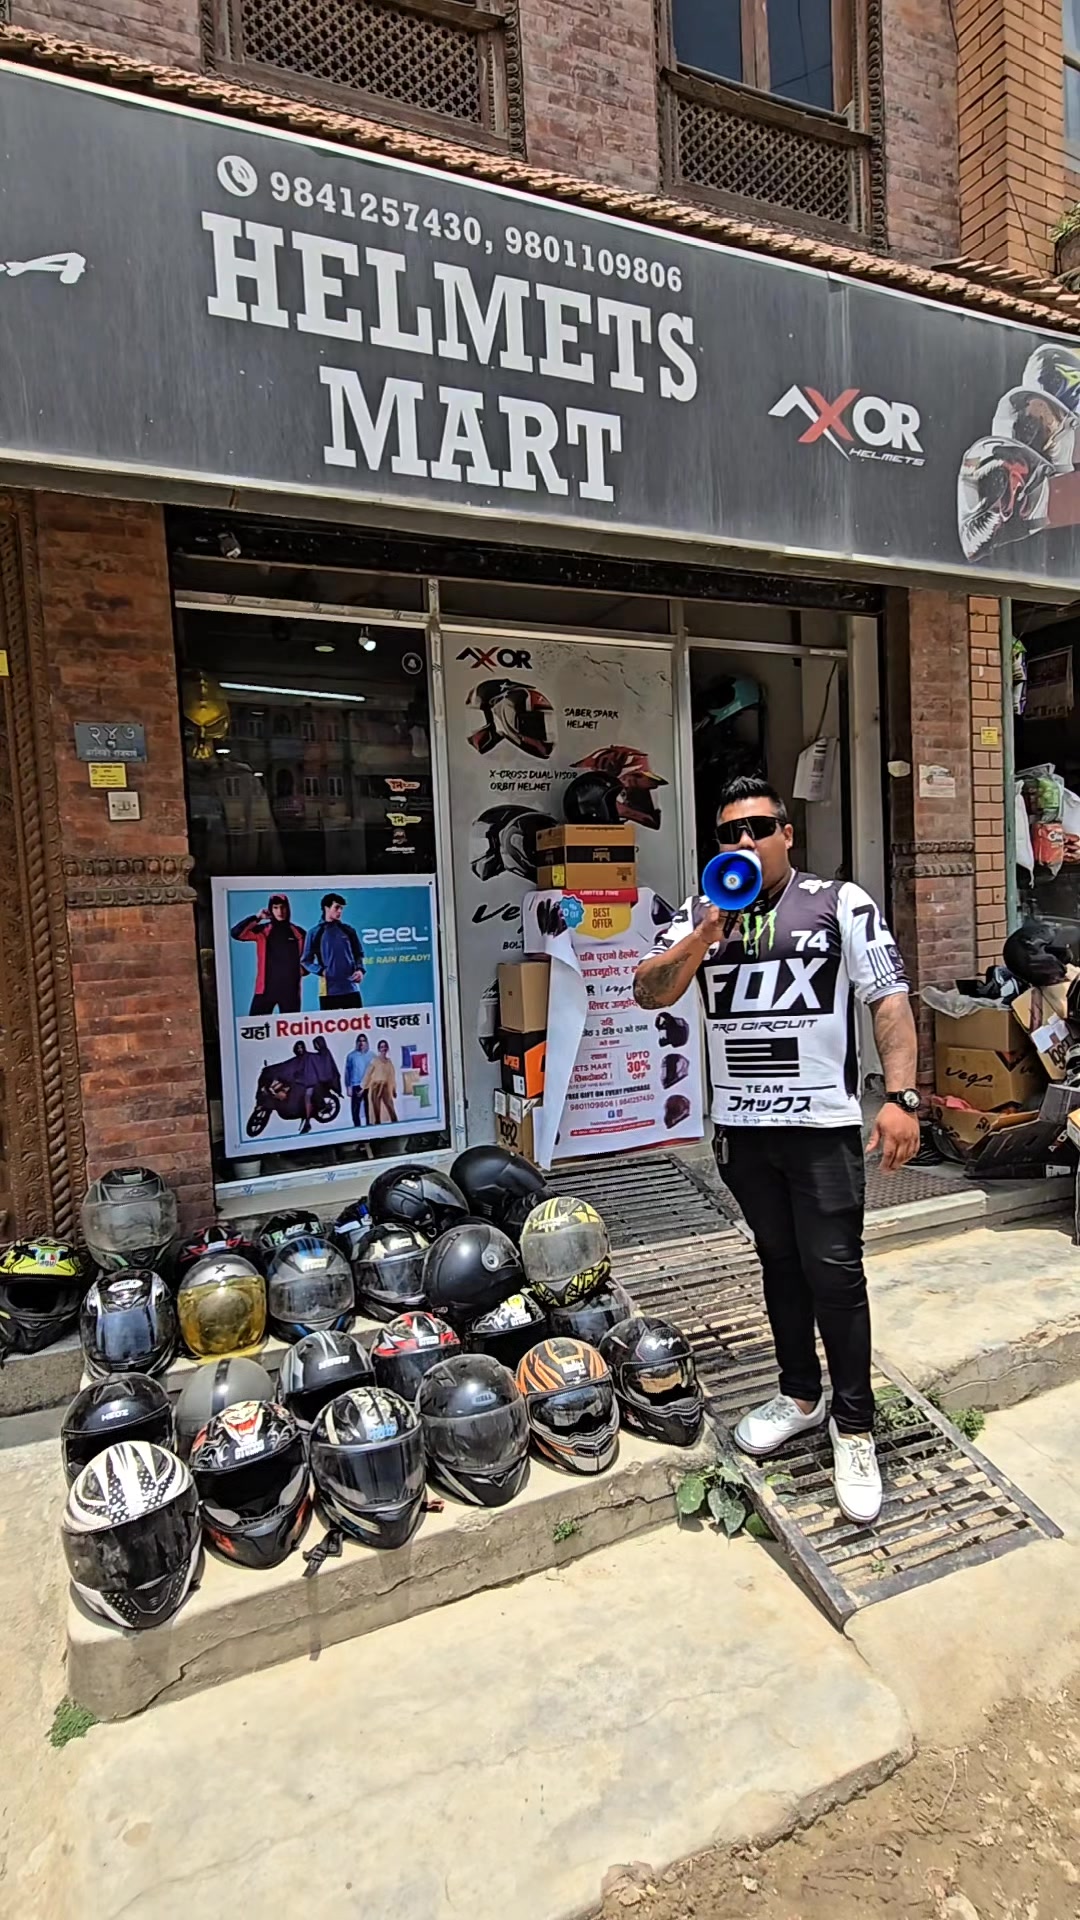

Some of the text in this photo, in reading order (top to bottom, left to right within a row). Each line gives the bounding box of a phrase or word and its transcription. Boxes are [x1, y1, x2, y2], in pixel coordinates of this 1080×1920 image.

[271, 171, 682, 292] 9841257430, 9801109806
[201, 211, 698, 402] HELMETS
[767, 384, 924, 462] AXOR
[319, 365, 622, 502] MART
[849, 447, 926, 467] HELMETS
[455, 646, 533, 673] AXOR
[564, 707, 619, 719] SABER SPARK
[567, 719, 598, 730] HELMET
[489, 769, 528, 780] X-CROSS
[529, 770, 553, 779] DUAL
[490, 782, 552, 791] ORBIT HELMET
[593, 907, 611, 918] BEST
[592, 918, 613, 929] OFFER
[791, 929, 830, 952] 74
[376, 955, 397, 964] RAIN
[398, 954, 431, 963] READY!
[704, 957, 829, 1014] FOX
[276, 1012, 372, 1037] Raincoat
[375, 1013, 421, 1029] पाइन्छ
[712, 1018, 818, 1034] PRO CIRCUIT
[626, 1050, 650, 1060] UPTO
[591, 1062, 612, 1071] MART
[627, 1060, 651, 1073] 30%
[632, 1072, 646, 1080] OFF
[580, 1091, 594, 1099] GIFT
[605, 1087, 622, 1096] EVERY
[623, 1084, 651, 1094] PURCHASE
[746, 1085, 783, 1094] TEAM
[727, 1096, 812, 1114] フォックス
